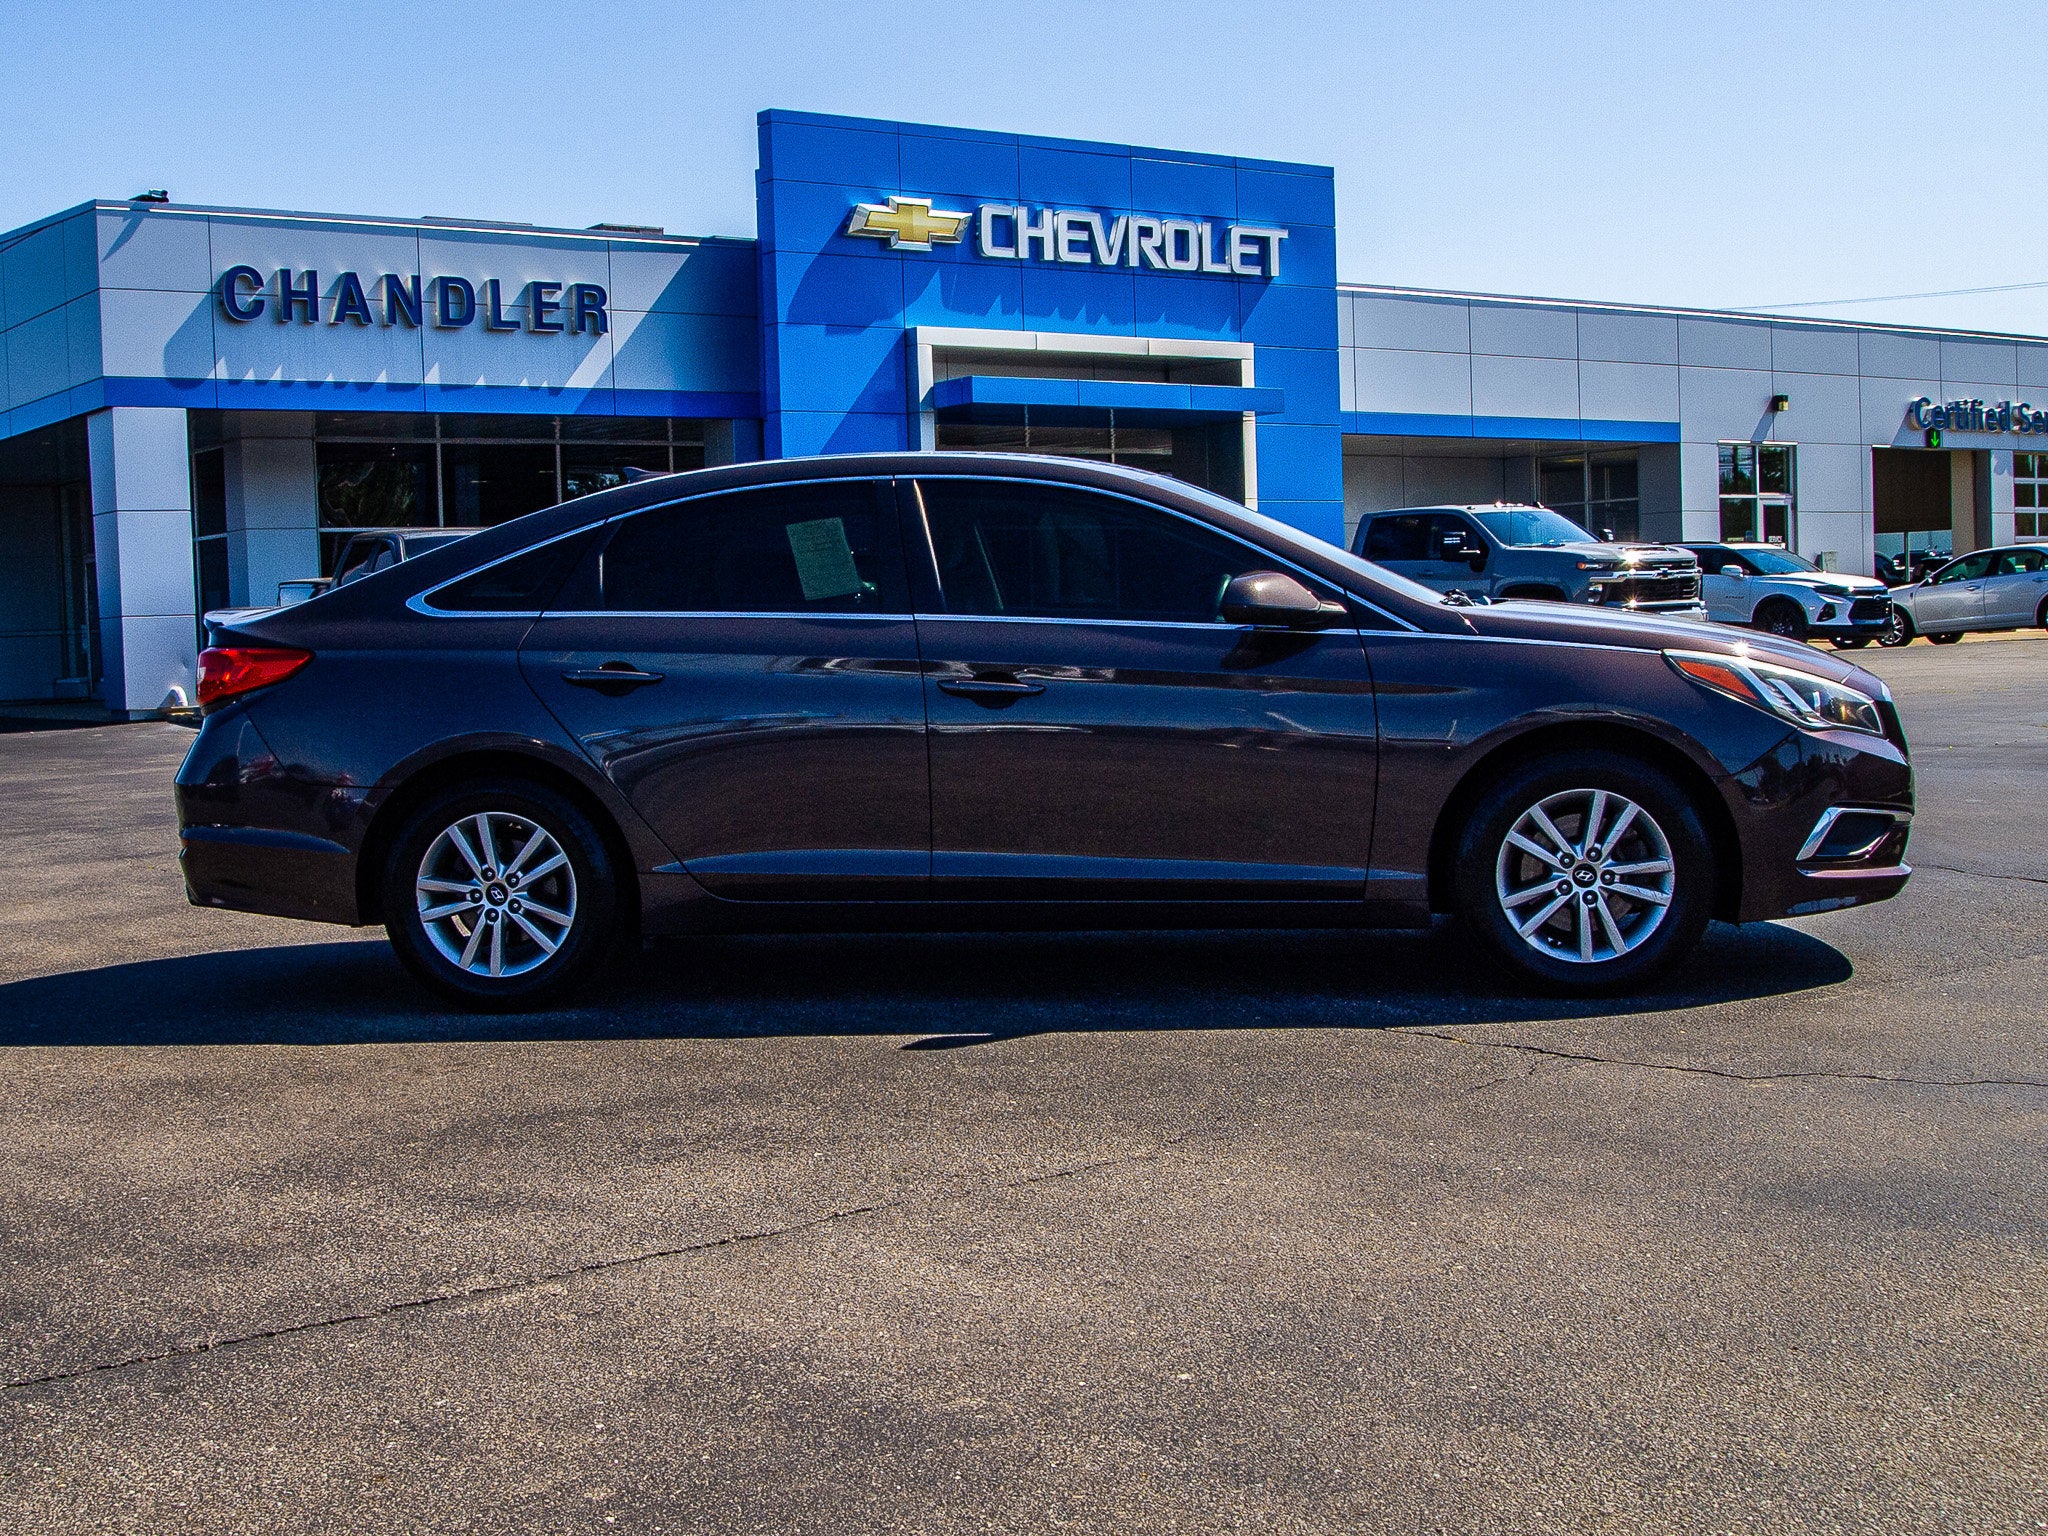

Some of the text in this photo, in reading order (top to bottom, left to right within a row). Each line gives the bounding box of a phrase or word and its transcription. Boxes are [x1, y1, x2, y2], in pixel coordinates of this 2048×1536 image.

[977, 203, 1288, 277] CHEVROLET
[222, 264, 609, 334] CHANDLER
[1912, 396, 2010, 432] Certified
